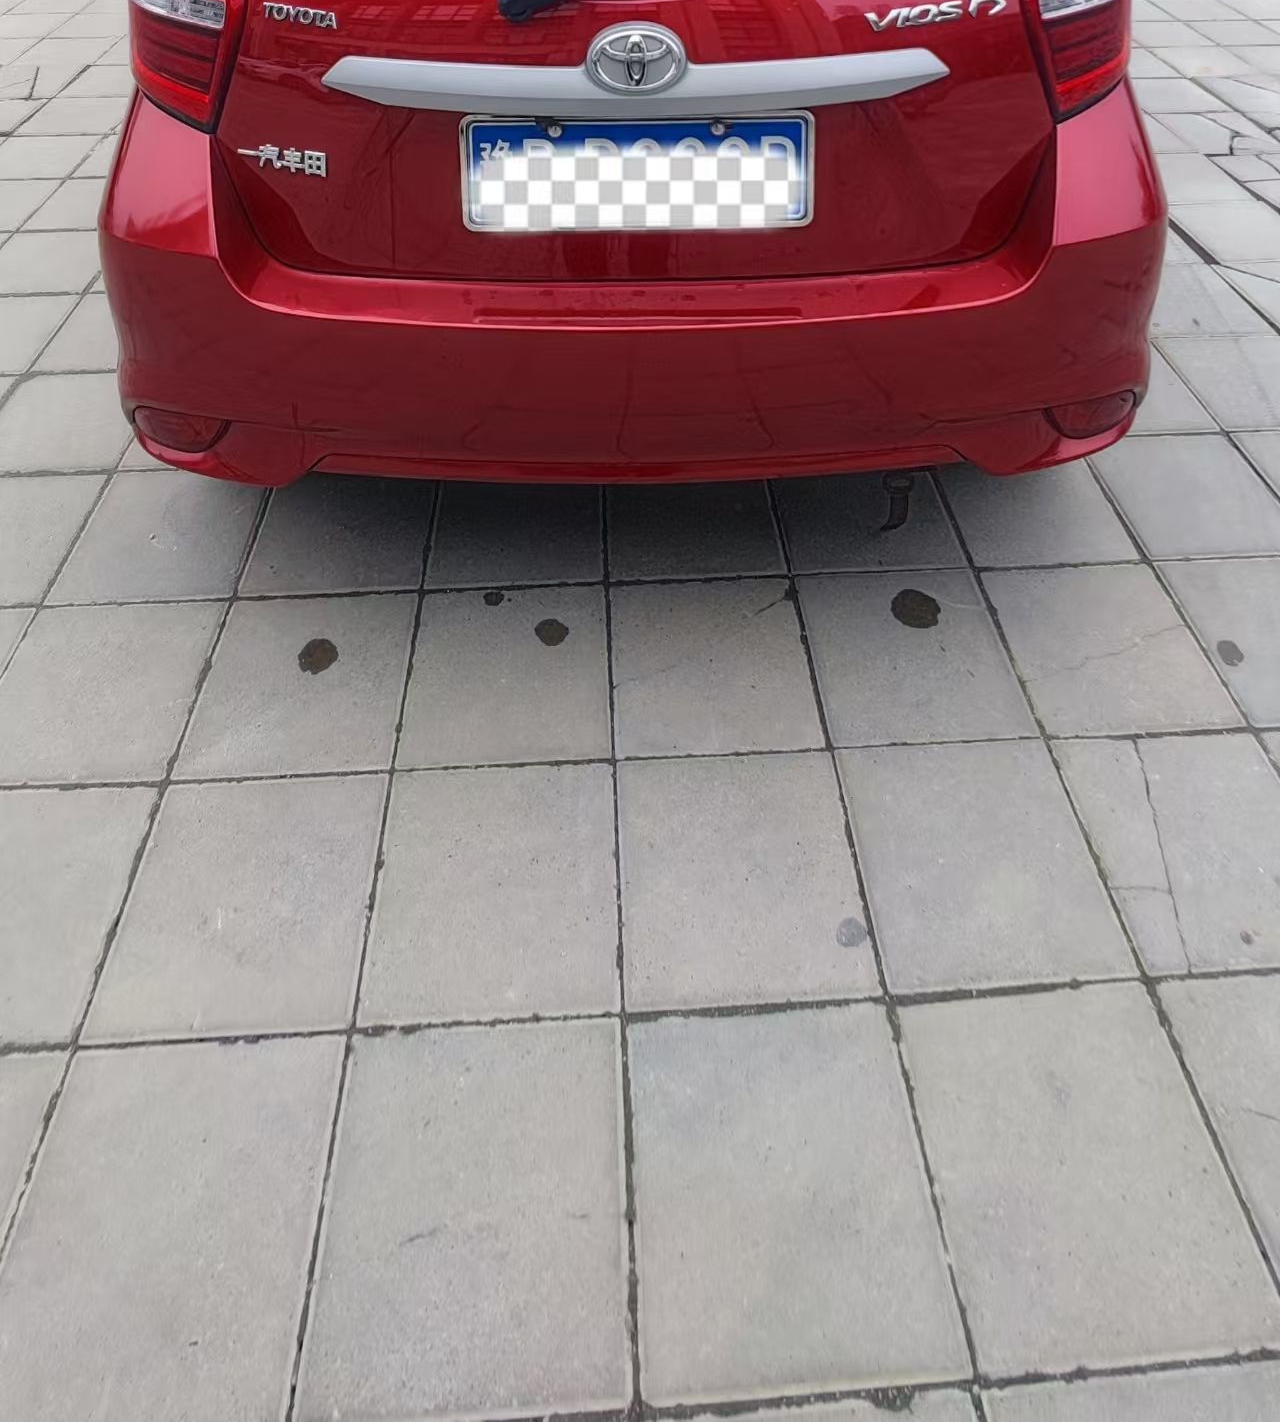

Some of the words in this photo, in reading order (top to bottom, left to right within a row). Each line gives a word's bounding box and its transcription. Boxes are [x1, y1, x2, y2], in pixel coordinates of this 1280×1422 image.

[263, 2, 337, 29] TOYOTA
[864, 0, 963, 32] VIOS
[237, 144, 327, 178] 一汽丰田
